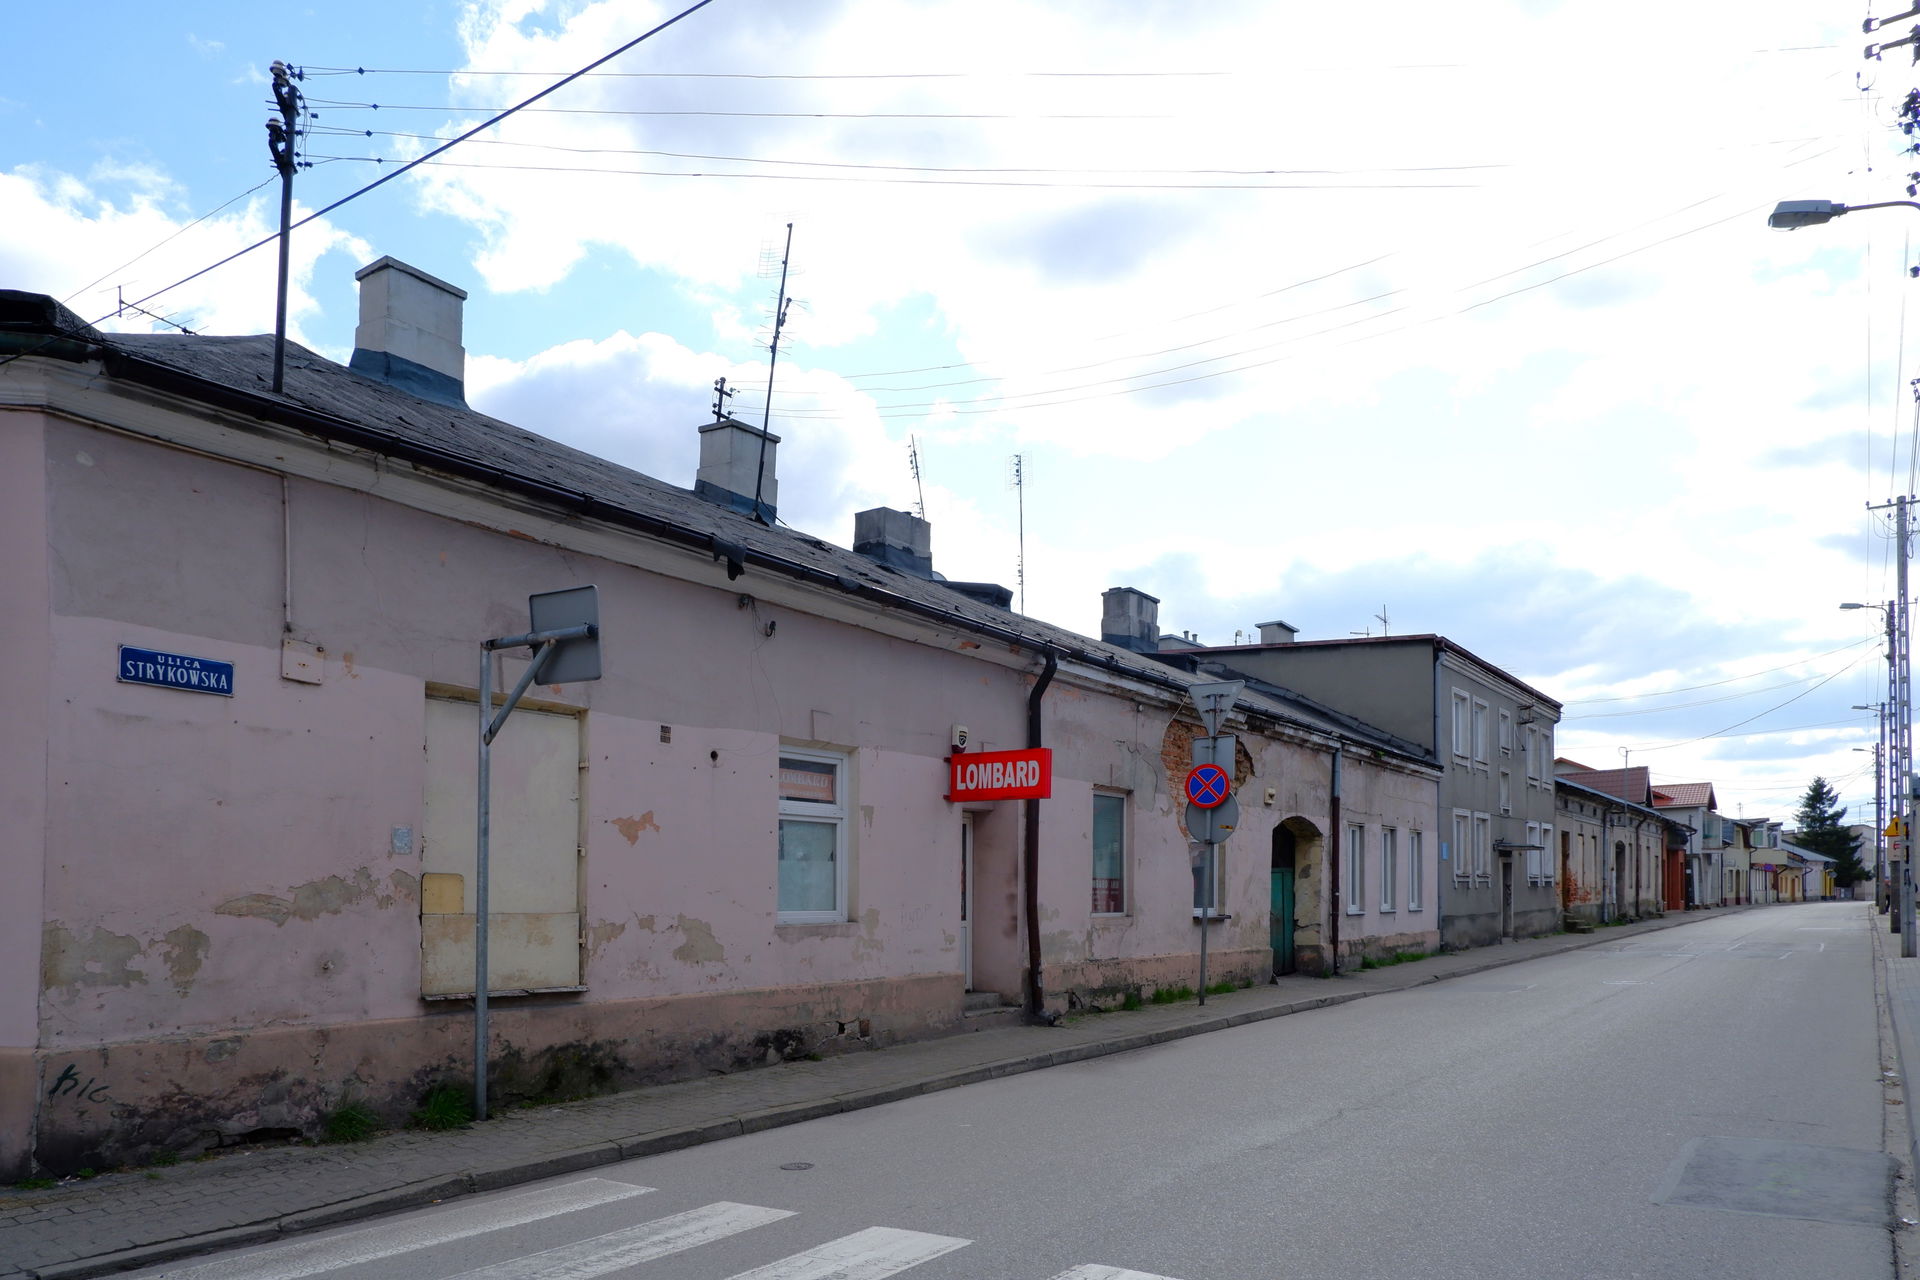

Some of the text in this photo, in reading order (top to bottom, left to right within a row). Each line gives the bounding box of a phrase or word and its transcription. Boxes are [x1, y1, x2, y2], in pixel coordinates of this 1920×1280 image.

[126, 660, 228, 690] STRYKOWSKA
[157, 655, 201, 669] ULICA
[956, 760, 1040, 790] LOMBARD
